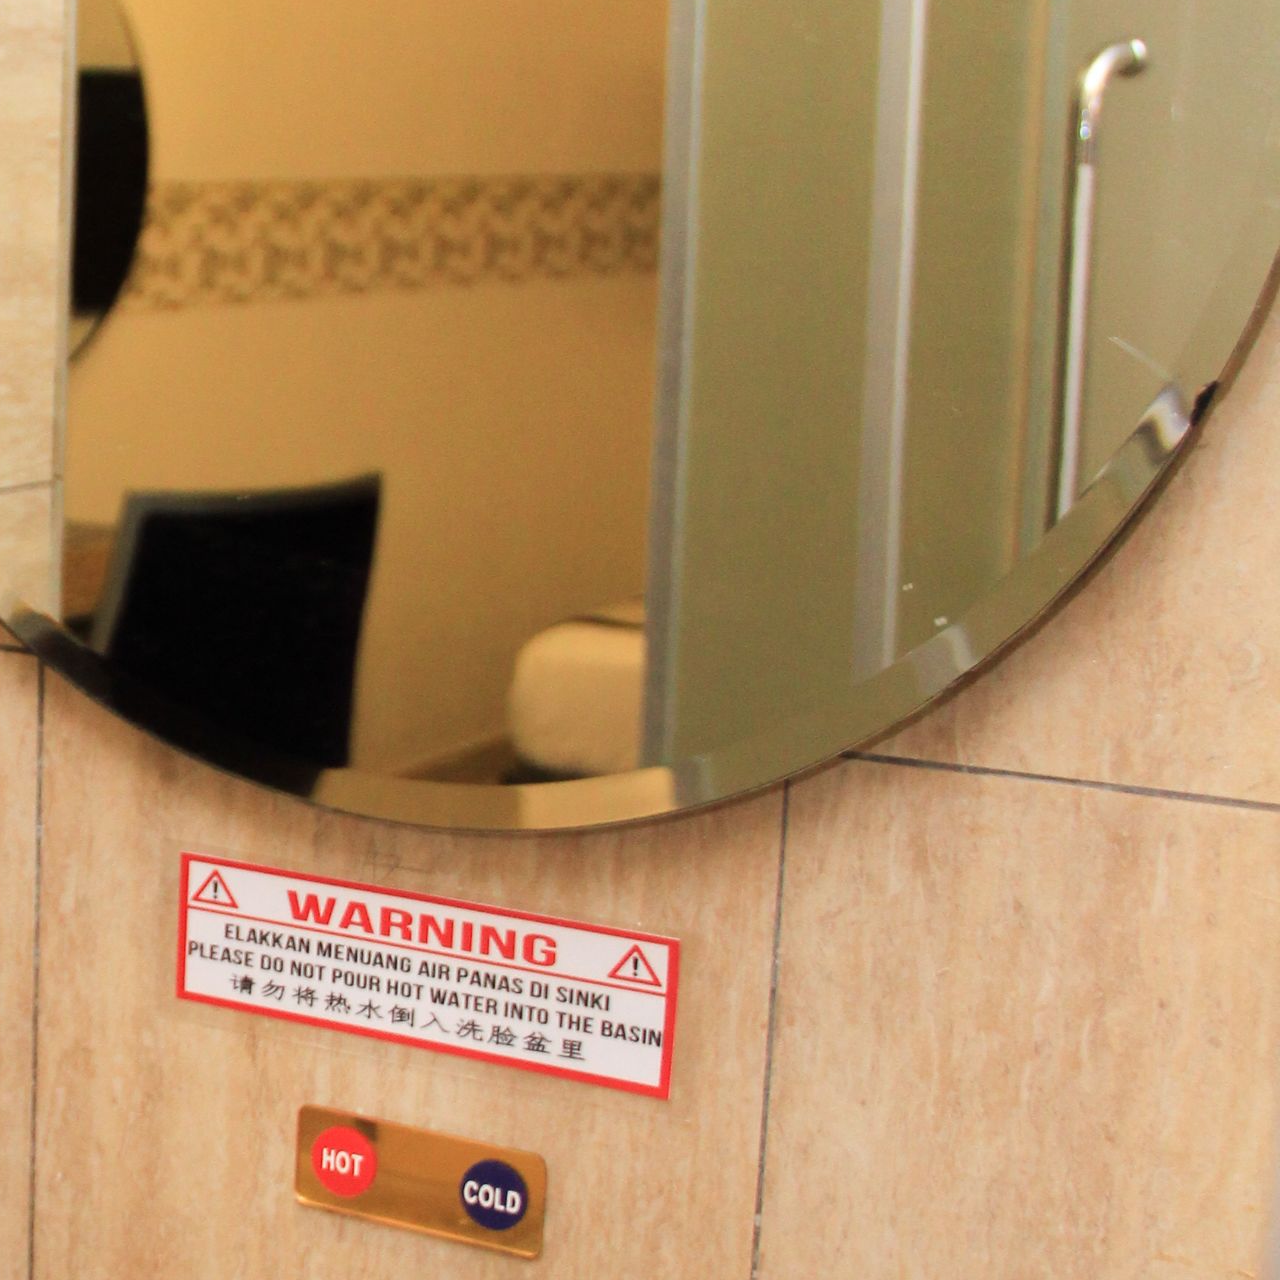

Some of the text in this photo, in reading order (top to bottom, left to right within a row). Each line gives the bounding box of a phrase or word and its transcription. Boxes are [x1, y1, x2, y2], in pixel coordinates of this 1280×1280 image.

[224, 922, 611, 1012] ELAKKAN MENUANG AIR PANAS DI SINKI
[287, 889, 557, 966] WARNING
[187, 940, 662, 1048] PLEASE DO NOT POUR HOT WATER INTO THE BASIN
[229, 972, 586, 1062] 请勿将热水倒入洗脸盆里
[321, 1146, 365, 1178] HOT
[462, 1179, 521, 1215] COLD
